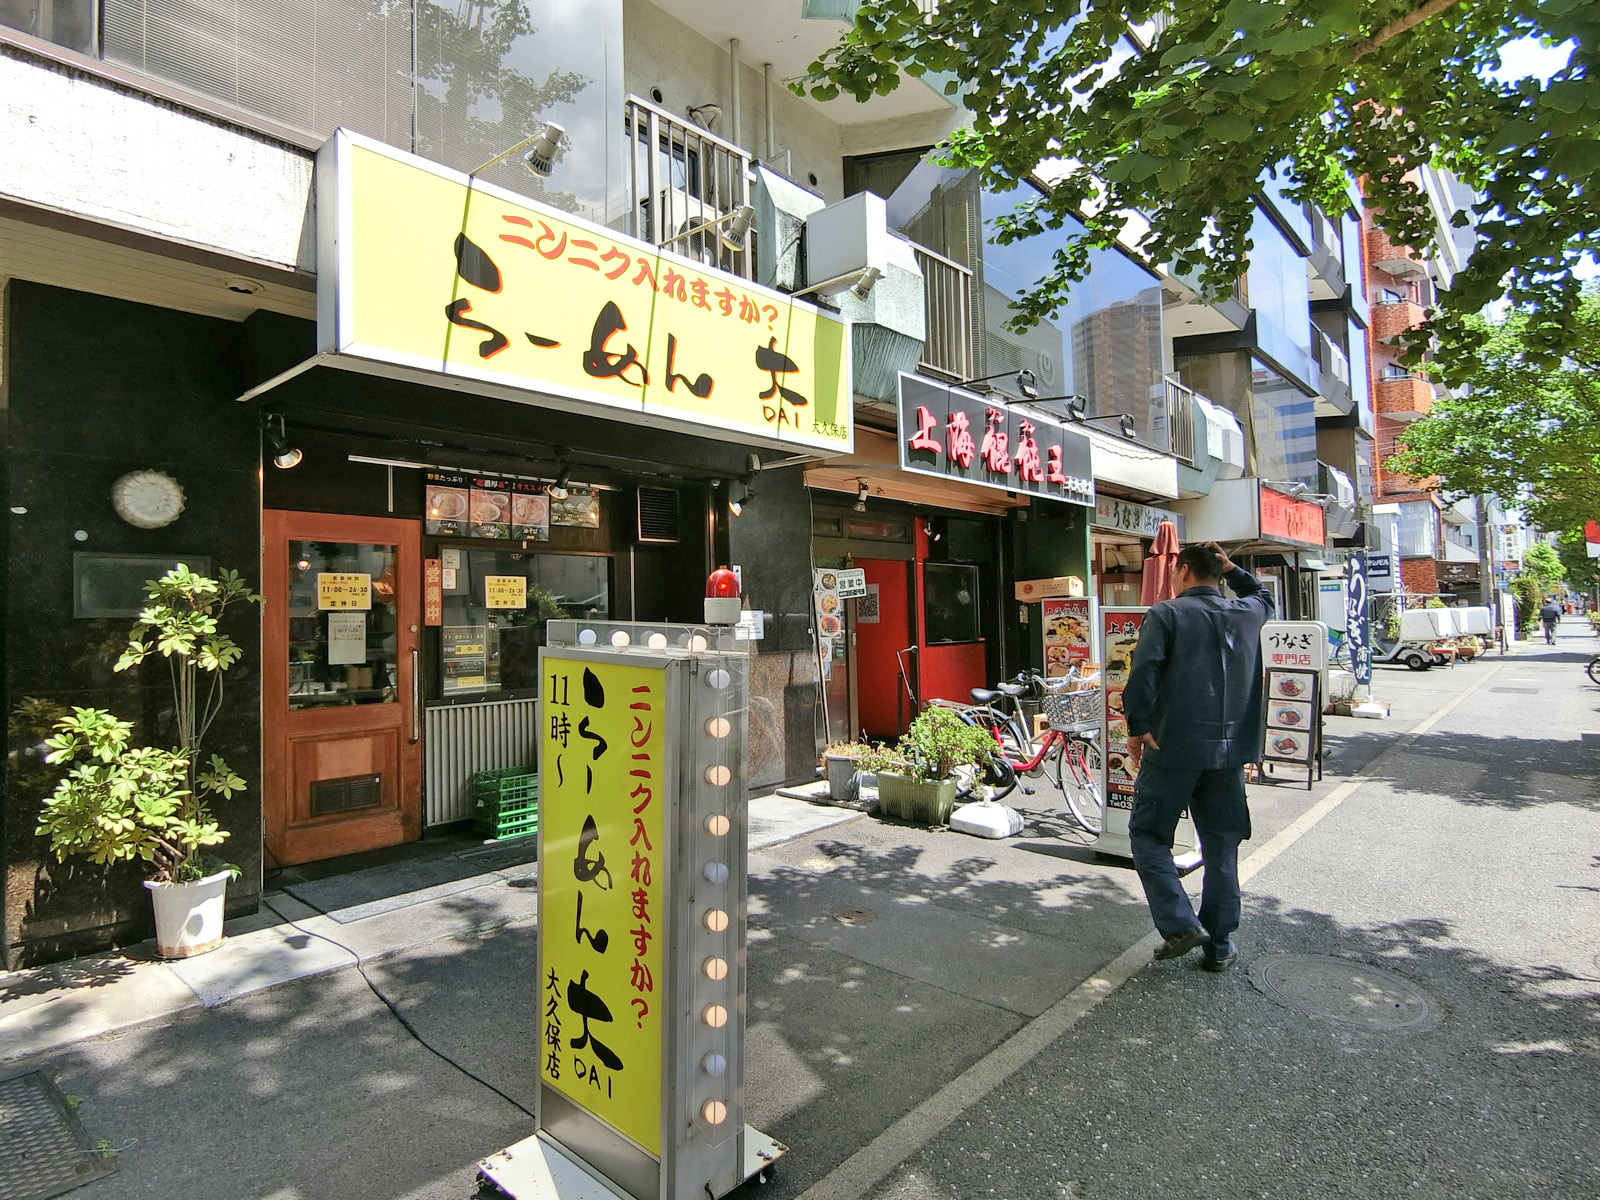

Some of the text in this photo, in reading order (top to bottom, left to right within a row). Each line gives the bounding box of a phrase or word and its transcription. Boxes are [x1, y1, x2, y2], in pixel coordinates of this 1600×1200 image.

[762, 404, 800, 430] DAI
[812, 418, 847, 440] 大久保店
[838, 578, 863, 590] 営業中
[1268, 632, 1314, 650] うなぎ
[1271, 653, 1312, 666] 専門店
[628, 685, 654, 1030] ニンニク入れますか?
[545, 966, 562, 1081] 大久保店
[573, 1053, 613, 1100] DAI
